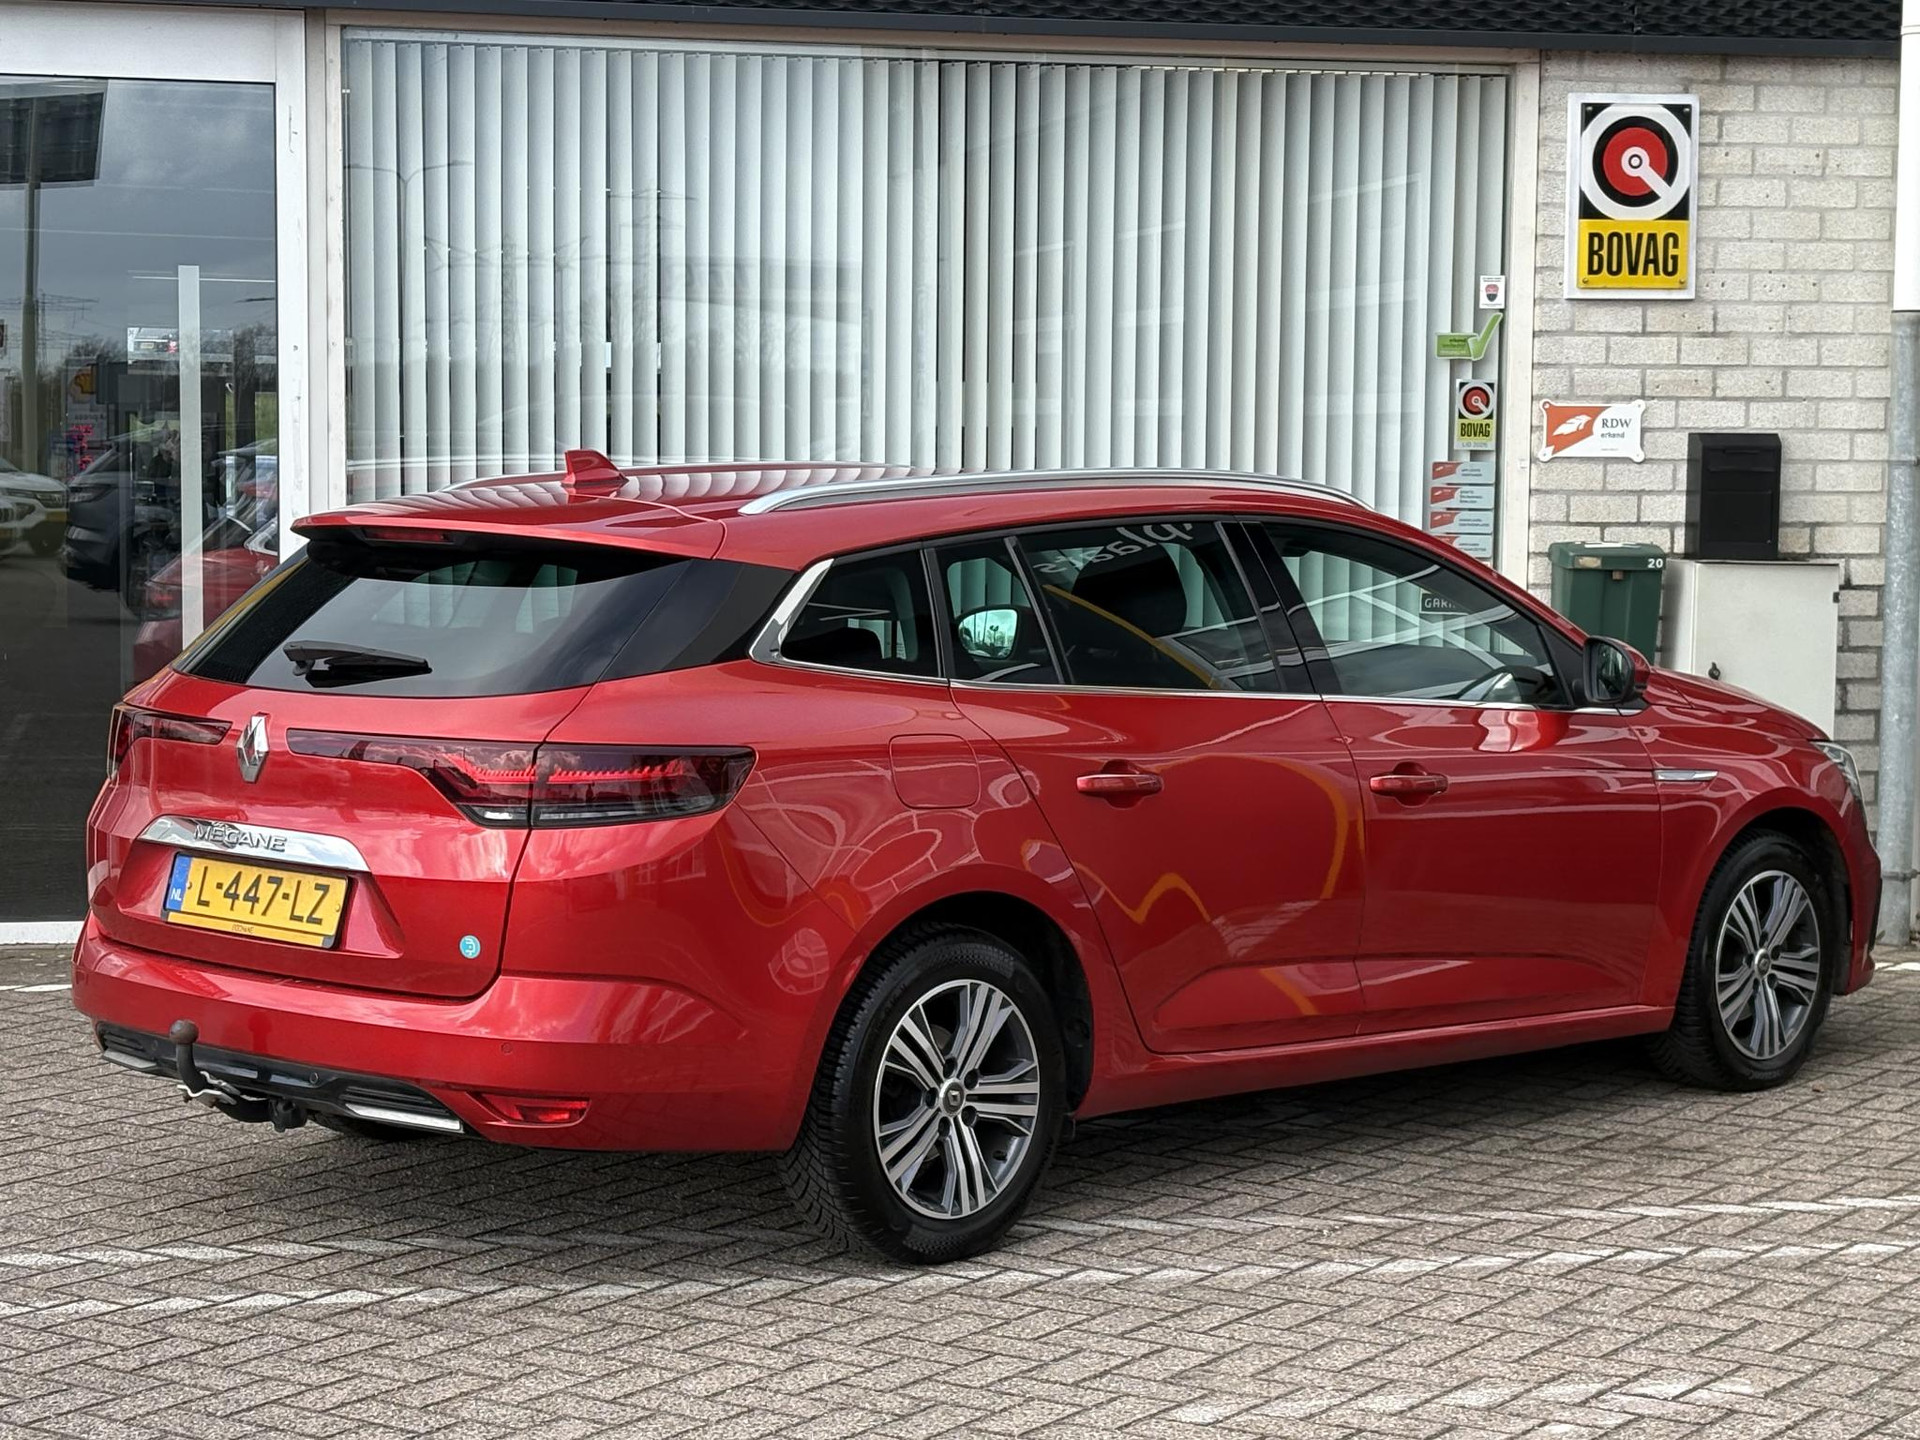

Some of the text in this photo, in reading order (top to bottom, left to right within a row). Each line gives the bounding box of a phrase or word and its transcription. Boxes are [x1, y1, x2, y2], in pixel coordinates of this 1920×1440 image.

[1588, 231, 1679, 277] BOVAG
[1460, 422, 1491, 438] BOVAG
[1601, 417, 1632, 429] RDW
[1647, 557, 1664, 569] 20
[171, 887, 183, 901] NL
[196, 865, 331, 926] L-447-LZ
